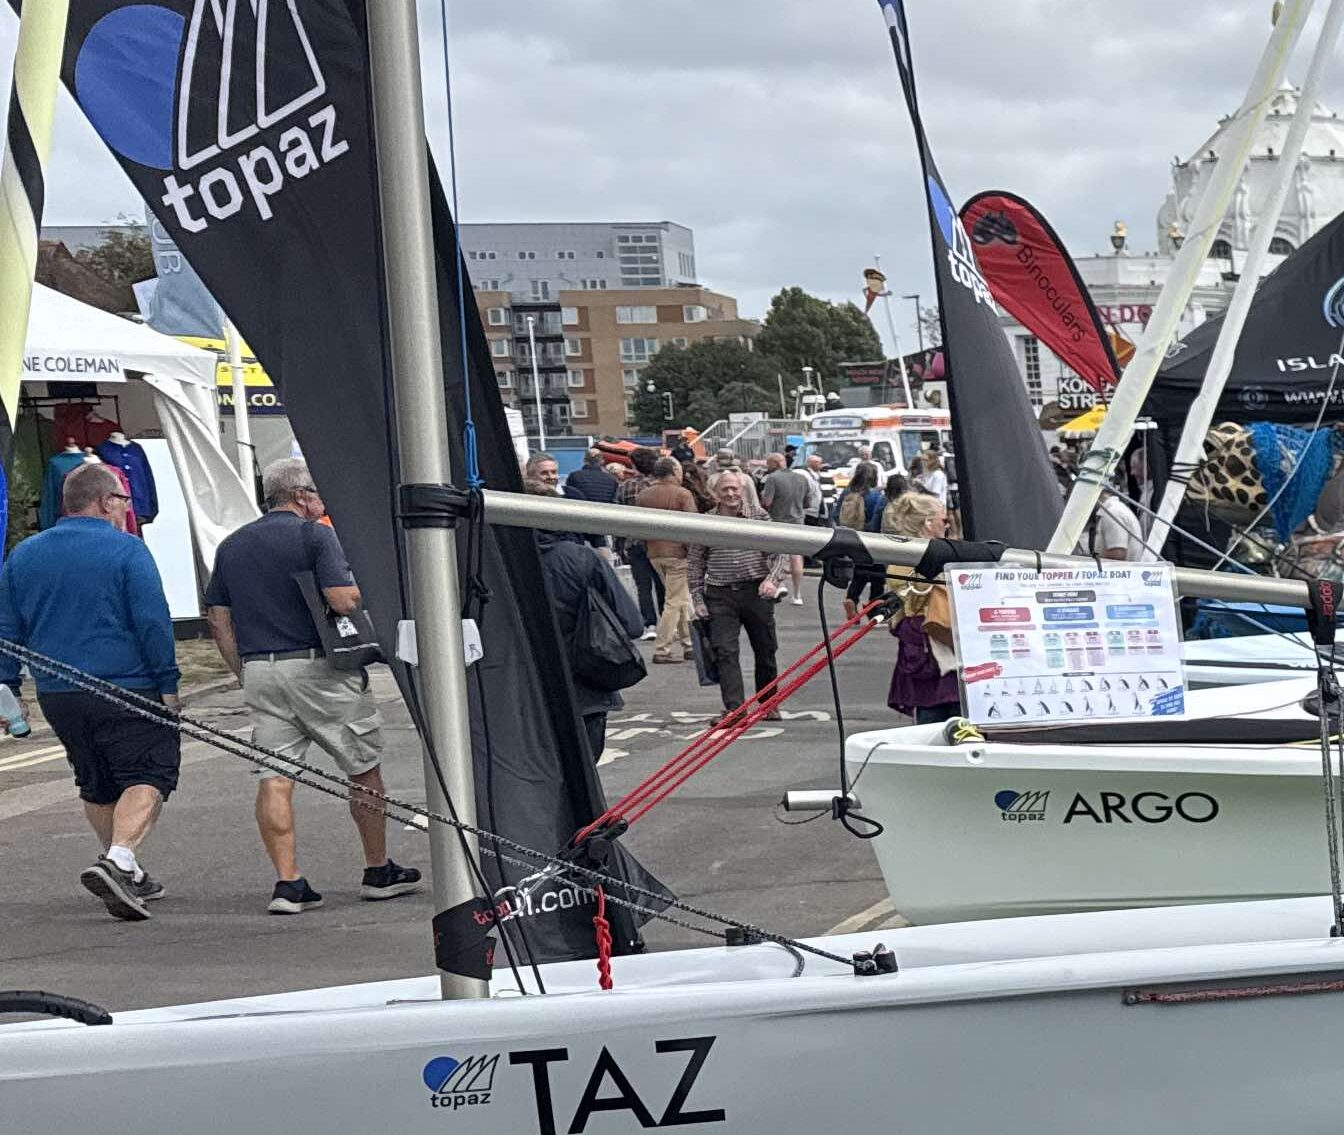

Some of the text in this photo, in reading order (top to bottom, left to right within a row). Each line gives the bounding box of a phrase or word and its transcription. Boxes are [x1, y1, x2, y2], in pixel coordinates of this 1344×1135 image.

[162, 104, 350, 233] topaz
[1016, 244, 1087, 343] Binoculars
[44, 358, 120, 374] COLEMAN
[995, 571, 1016, 581] FIND
[1018, 571, 1039, 580] YOUR
[1041, 571, 1073, 581] TOPPER
[1109, 570, 1132, 579] BOAT
[1001, 791, 1219, 824] topaz ARGO
[430, 1091, 491, 1110] topaz
